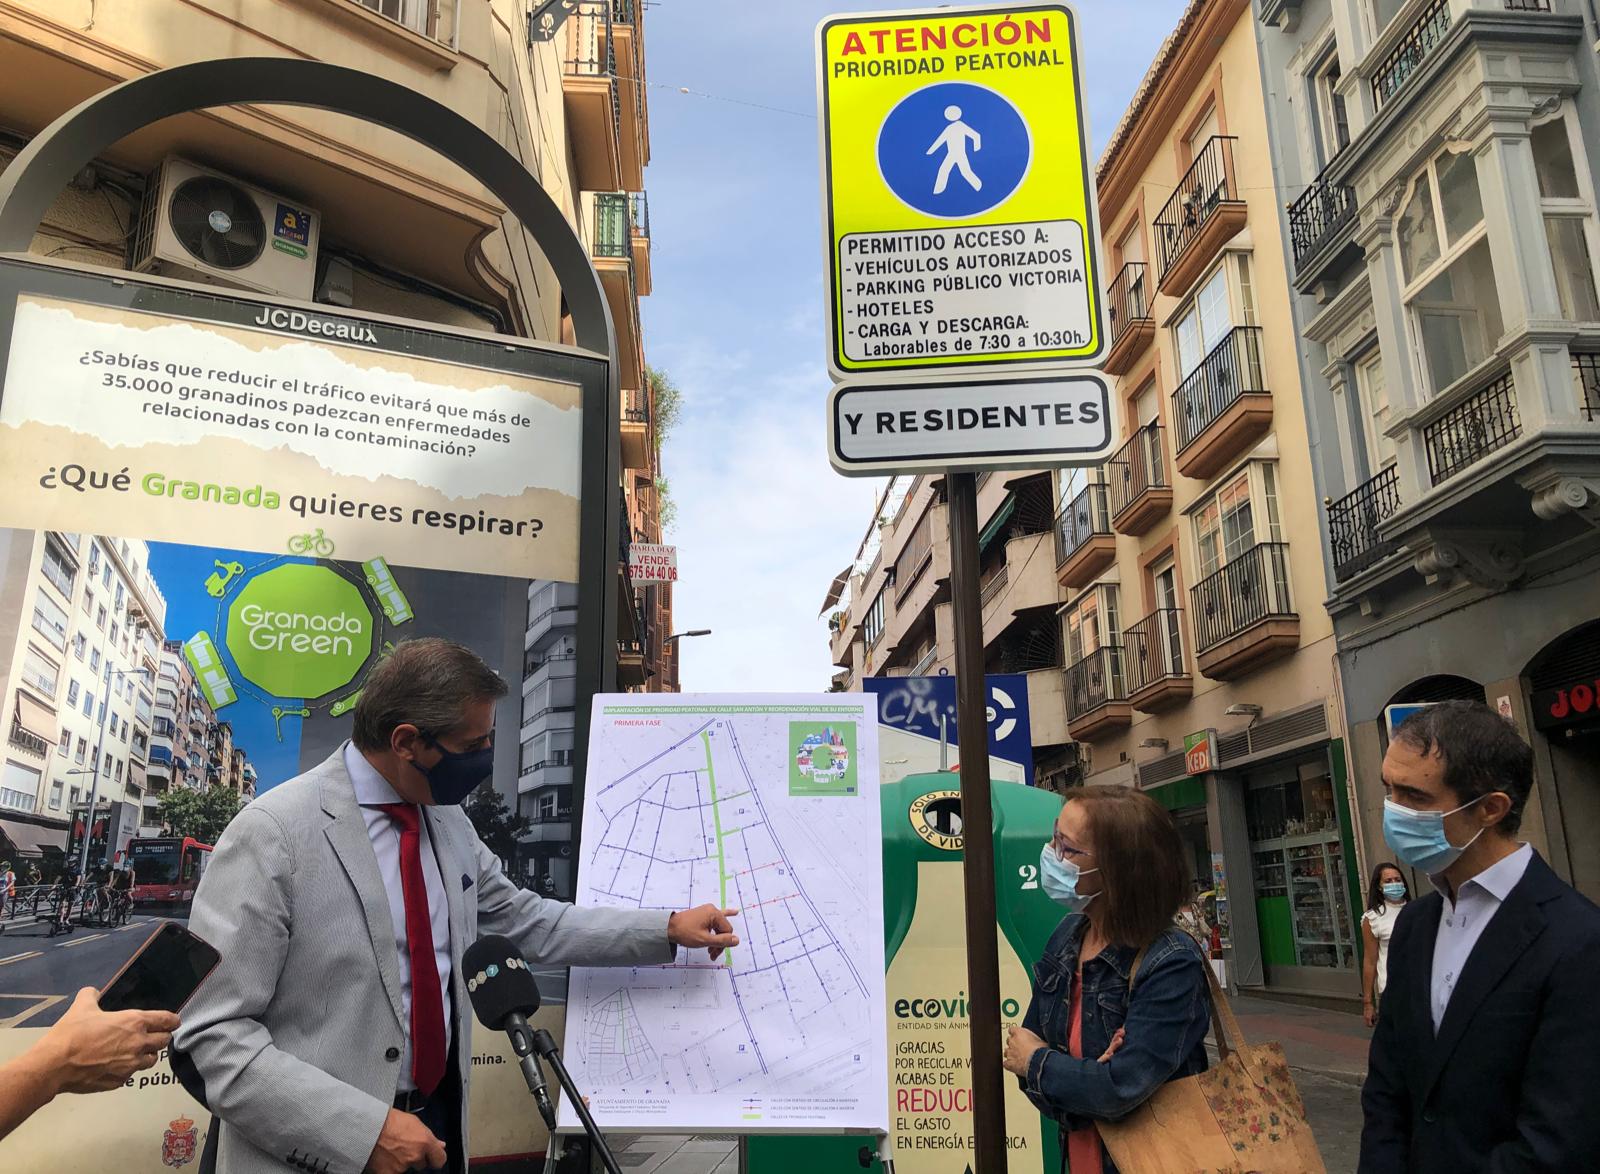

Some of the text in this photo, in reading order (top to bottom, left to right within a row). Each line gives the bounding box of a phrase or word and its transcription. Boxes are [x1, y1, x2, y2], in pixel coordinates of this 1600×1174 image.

[841, 14, 1052, 57] ATENCIÓN
[834, 49, 1065, 78] PRIORIDAD PEATONAL
[848, 229, 1049, 255] PERMITIDO ACCESO A:
[956, 249, 1072, 270] AUTORIZADOS
[933, 272, 1001, 292] PÚBLICO
[1009, 269, 1082, 288] VICTORIA
[254, 308, 378, 344] JCDecaux
[919, 320, 928, 335] Y
[937, 317, 1029, 335] DESCARGA:
[864, 331, 1086, 357] Laborables de 7:30 a 10:30h.
[79, 349, 531, 429] ¿Sabías que reducir el tráfico evitará que más de
[101, 371, 511, 444] 35.000 granadinos padezcan enfermedades
[844, 401, 1100, 436] Y RESIDENTES
[142, 398, 476, 458] relacionadas con la contaminación?
[39, 463, 544, 540] ¿Qué Granada quieres respirar?
[638, 555, 669, 565] VENDE
[645, 566, 654, 579] 64
[657, 566, 665, 579] 40
[668, 567, 677, 580] 06
[240, 604, 362, 635] Granada
[249, 622, 353, 656] Green
[1551, 678, 1600, 718] JO
[614, 719, 662, 727] PRIMERA FASE
[912, 793, 937, 813] SOLO
[918, 825, 935, 841] DE
[939, 836, 964, 848] VID
[1019, 865, 1038, 889] 2
[894, 991, 1020, 1018] ecovio
[897, 1022, 931, 1030] ENTIDAD
[949, 1021, 970, 1029] ÁNIM
[471, 1054, 507, 1065] mina.
[896, 1041, 945, 1056] ¡GRACIAS
[895, 1058, 915, 1069] POR
[918, 1057, 963, 1069] RECICLAR
[895, 1073, 954, 1085] ACABAS DE
[897, 1088, 973, 1113] REDUCI
[897, 1117, 951, 1130] EL GASTO
[897, 1132, 1027, 1149] EN ENERGÍA ERICA
